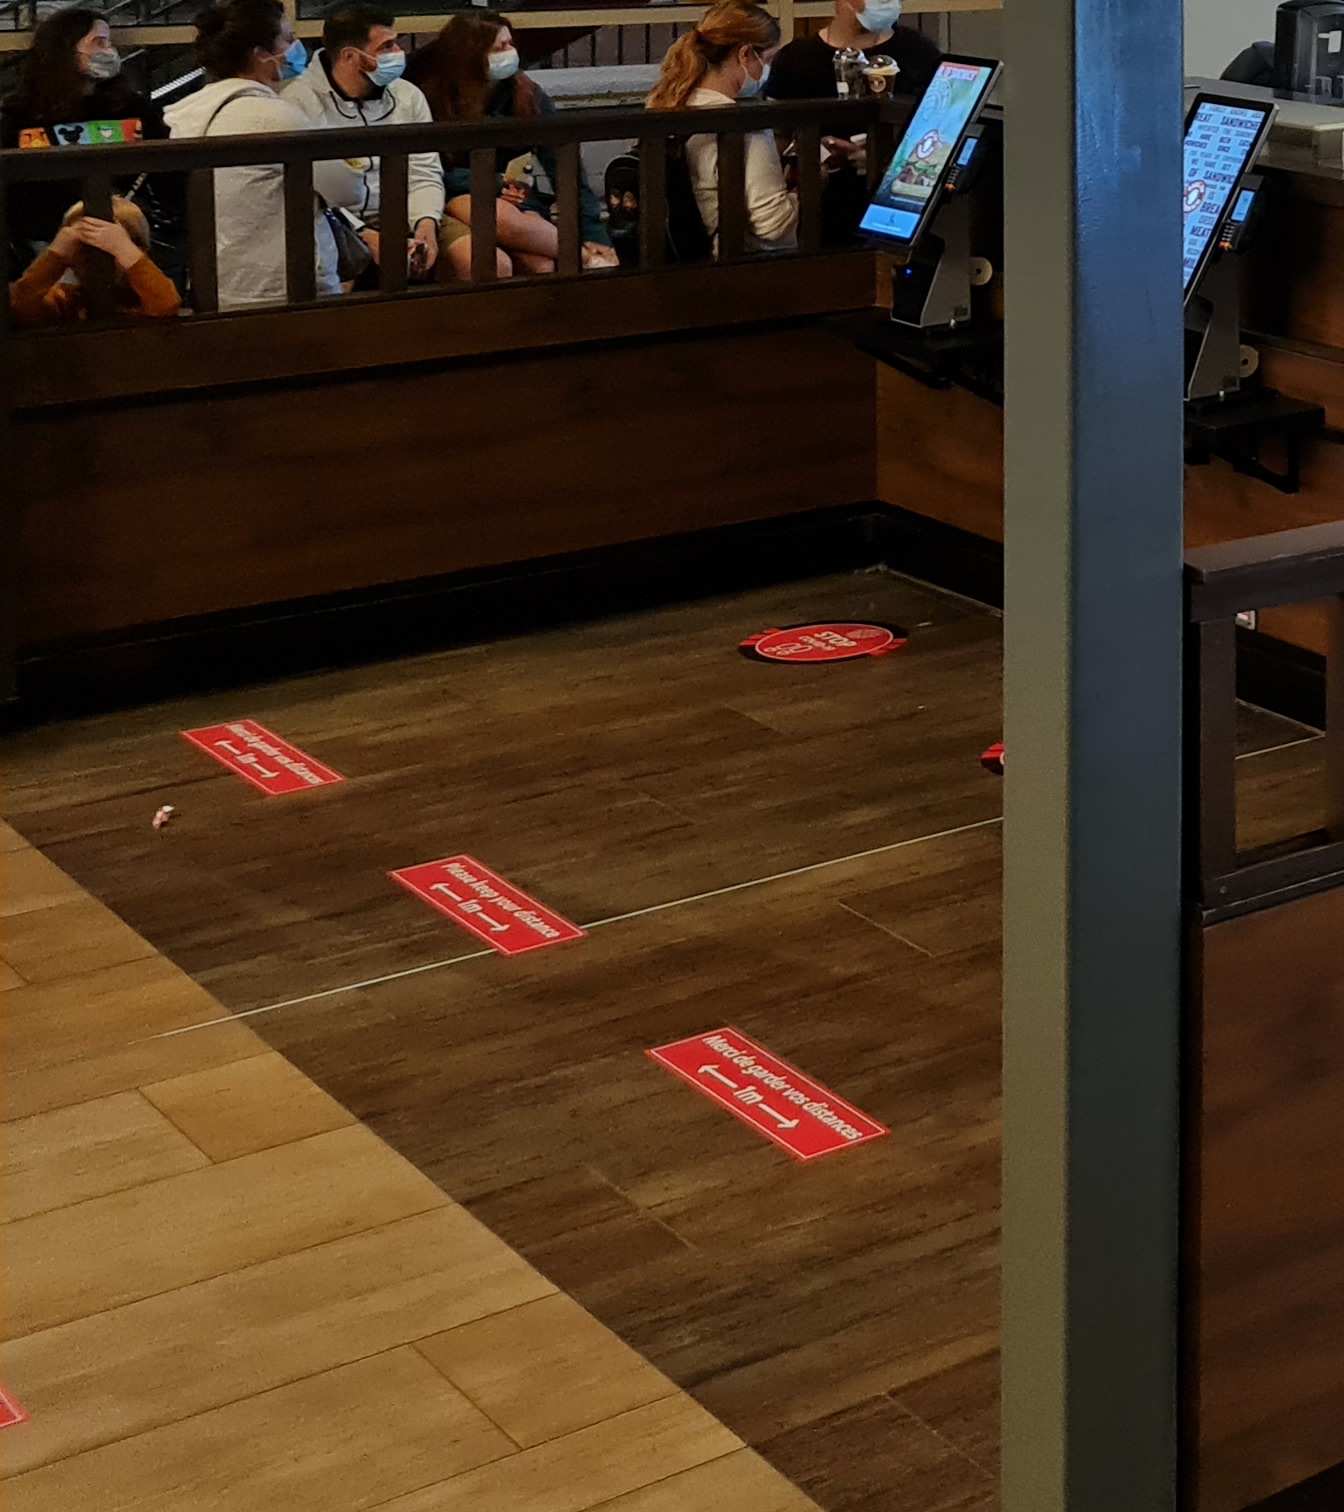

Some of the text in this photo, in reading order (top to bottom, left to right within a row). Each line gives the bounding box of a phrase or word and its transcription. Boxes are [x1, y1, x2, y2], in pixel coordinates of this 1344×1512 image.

[814, 630, 858, 648] STOP
[441, 862, 561, 939] Please keep your distance
[457, 899, 484, 914] 1m
[701, 1035, 864, 1141] Merci de garder vos distances
[733, 1085, 765, 1106] 1m
